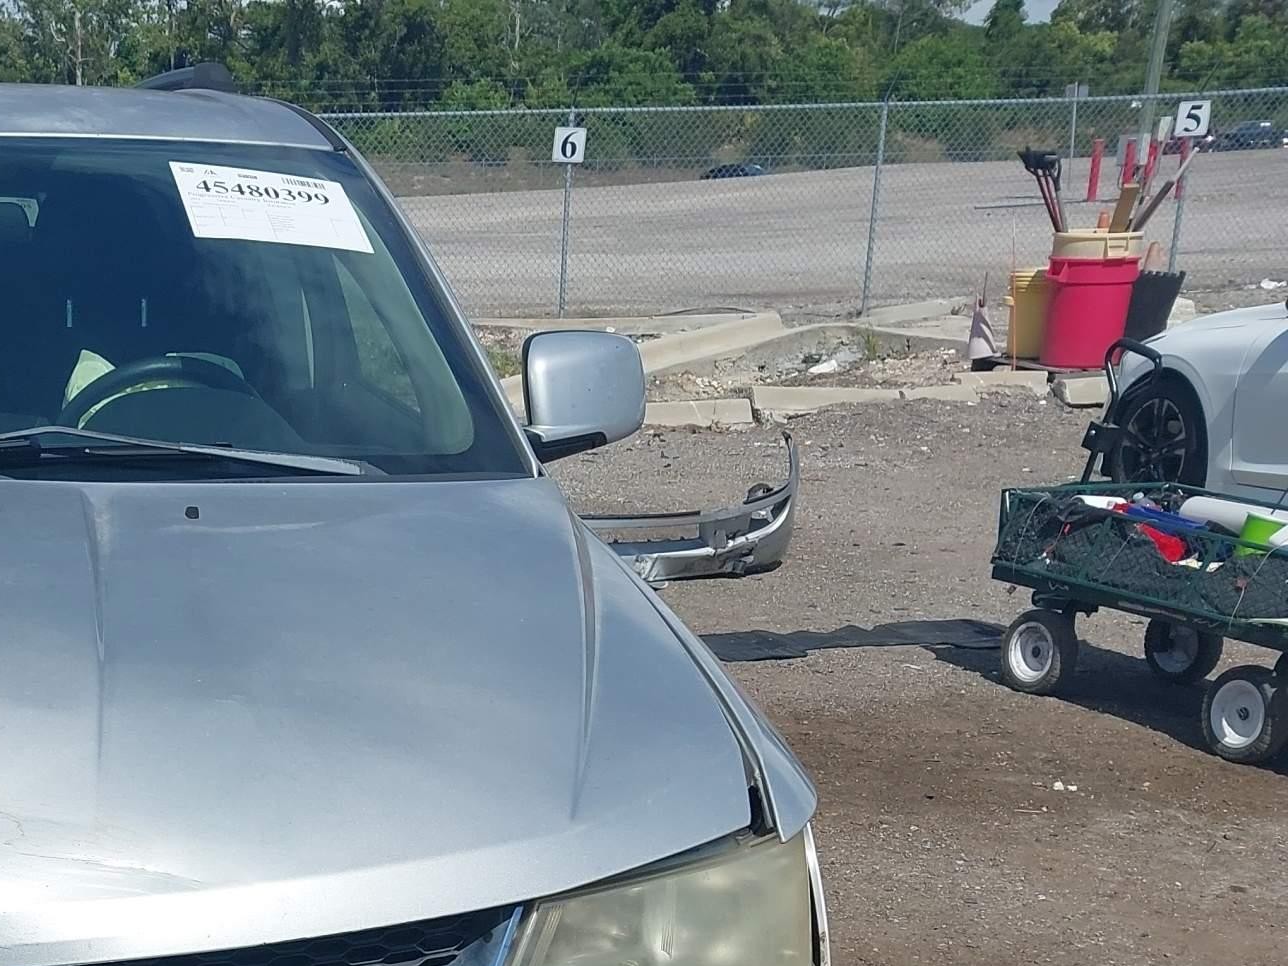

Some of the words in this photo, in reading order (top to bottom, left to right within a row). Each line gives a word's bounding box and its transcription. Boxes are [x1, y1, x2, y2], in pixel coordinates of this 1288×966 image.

[1183, 104, 1203, 132] 5
[561, 131, 578, 158] 6
[196, 180, 329, 205] 45480399
